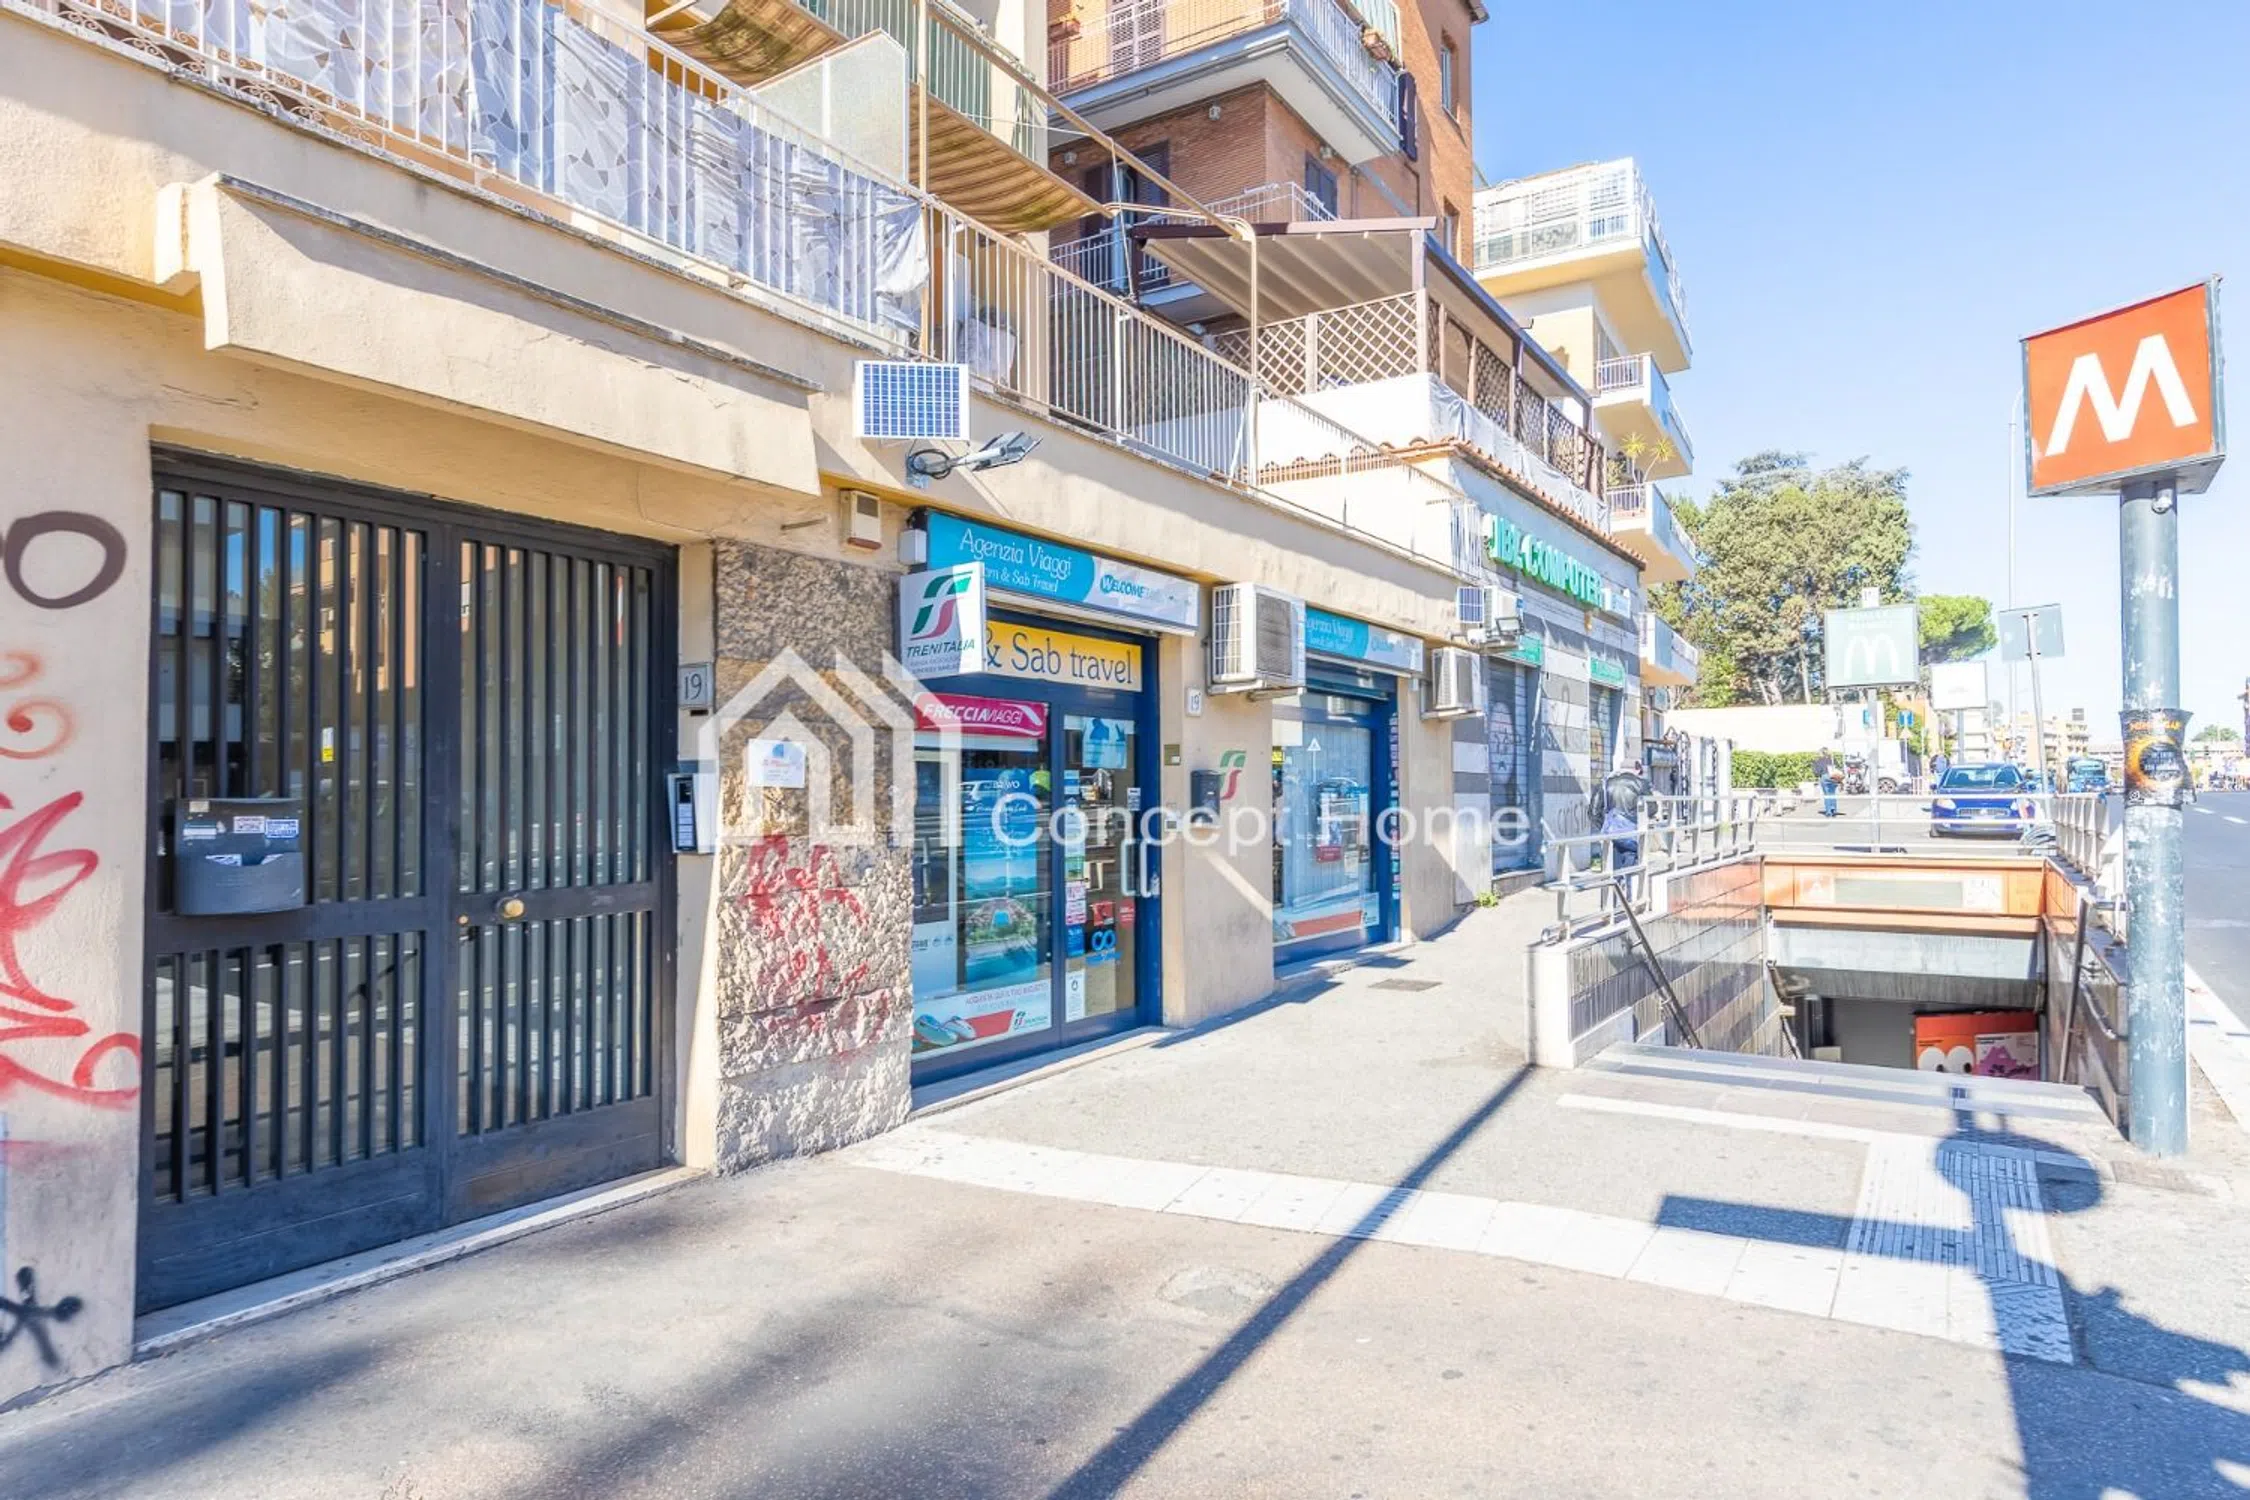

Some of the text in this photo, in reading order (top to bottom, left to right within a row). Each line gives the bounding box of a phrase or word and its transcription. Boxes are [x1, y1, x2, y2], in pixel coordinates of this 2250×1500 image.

[2045, 333, 2198, 457] M
[959, 528, 1072, 580] Agenzia Viaggi
[906, 639, 975, 658] TRENITALIA
[1011, 631, 1062, 675] Sab
[1069, 645, 1132, 684] travel
[683, 673, 702, 700] 19
